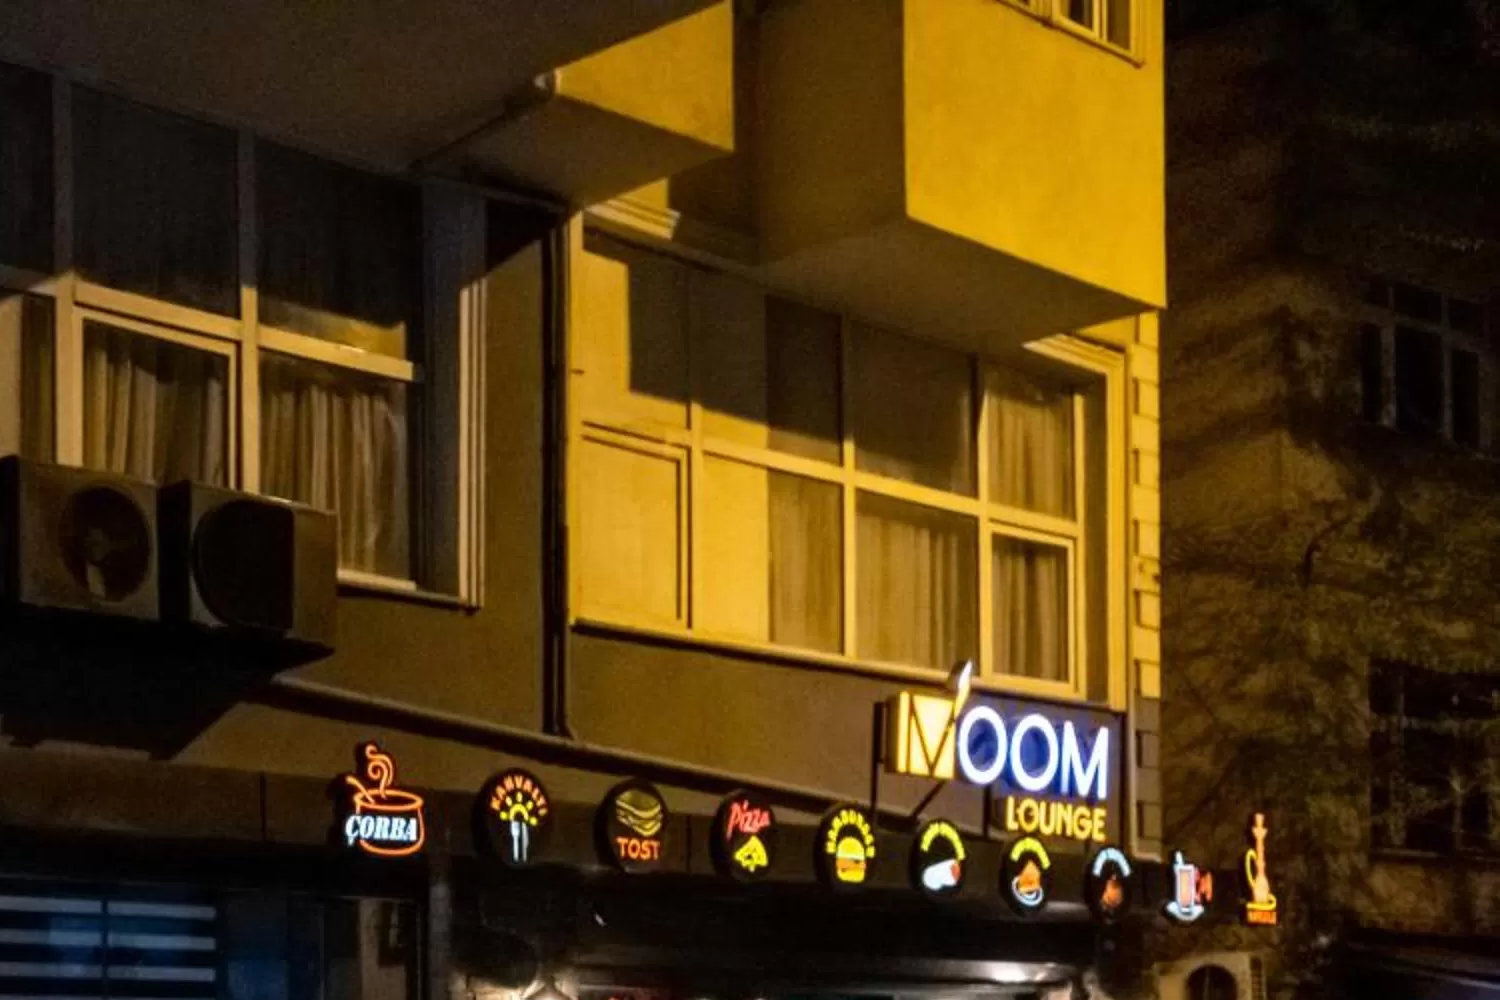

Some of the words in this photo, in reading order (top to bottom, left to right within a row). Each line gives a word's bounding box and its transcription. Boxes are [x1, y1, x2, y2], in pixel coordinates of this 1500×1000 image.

[345, 815, 417, 846] ÇORBA
[726, 800, 771, 839] Pizza
[1006, 796, 1107, 842] LOUNGE
[616, 836, 661, 861] TOST
